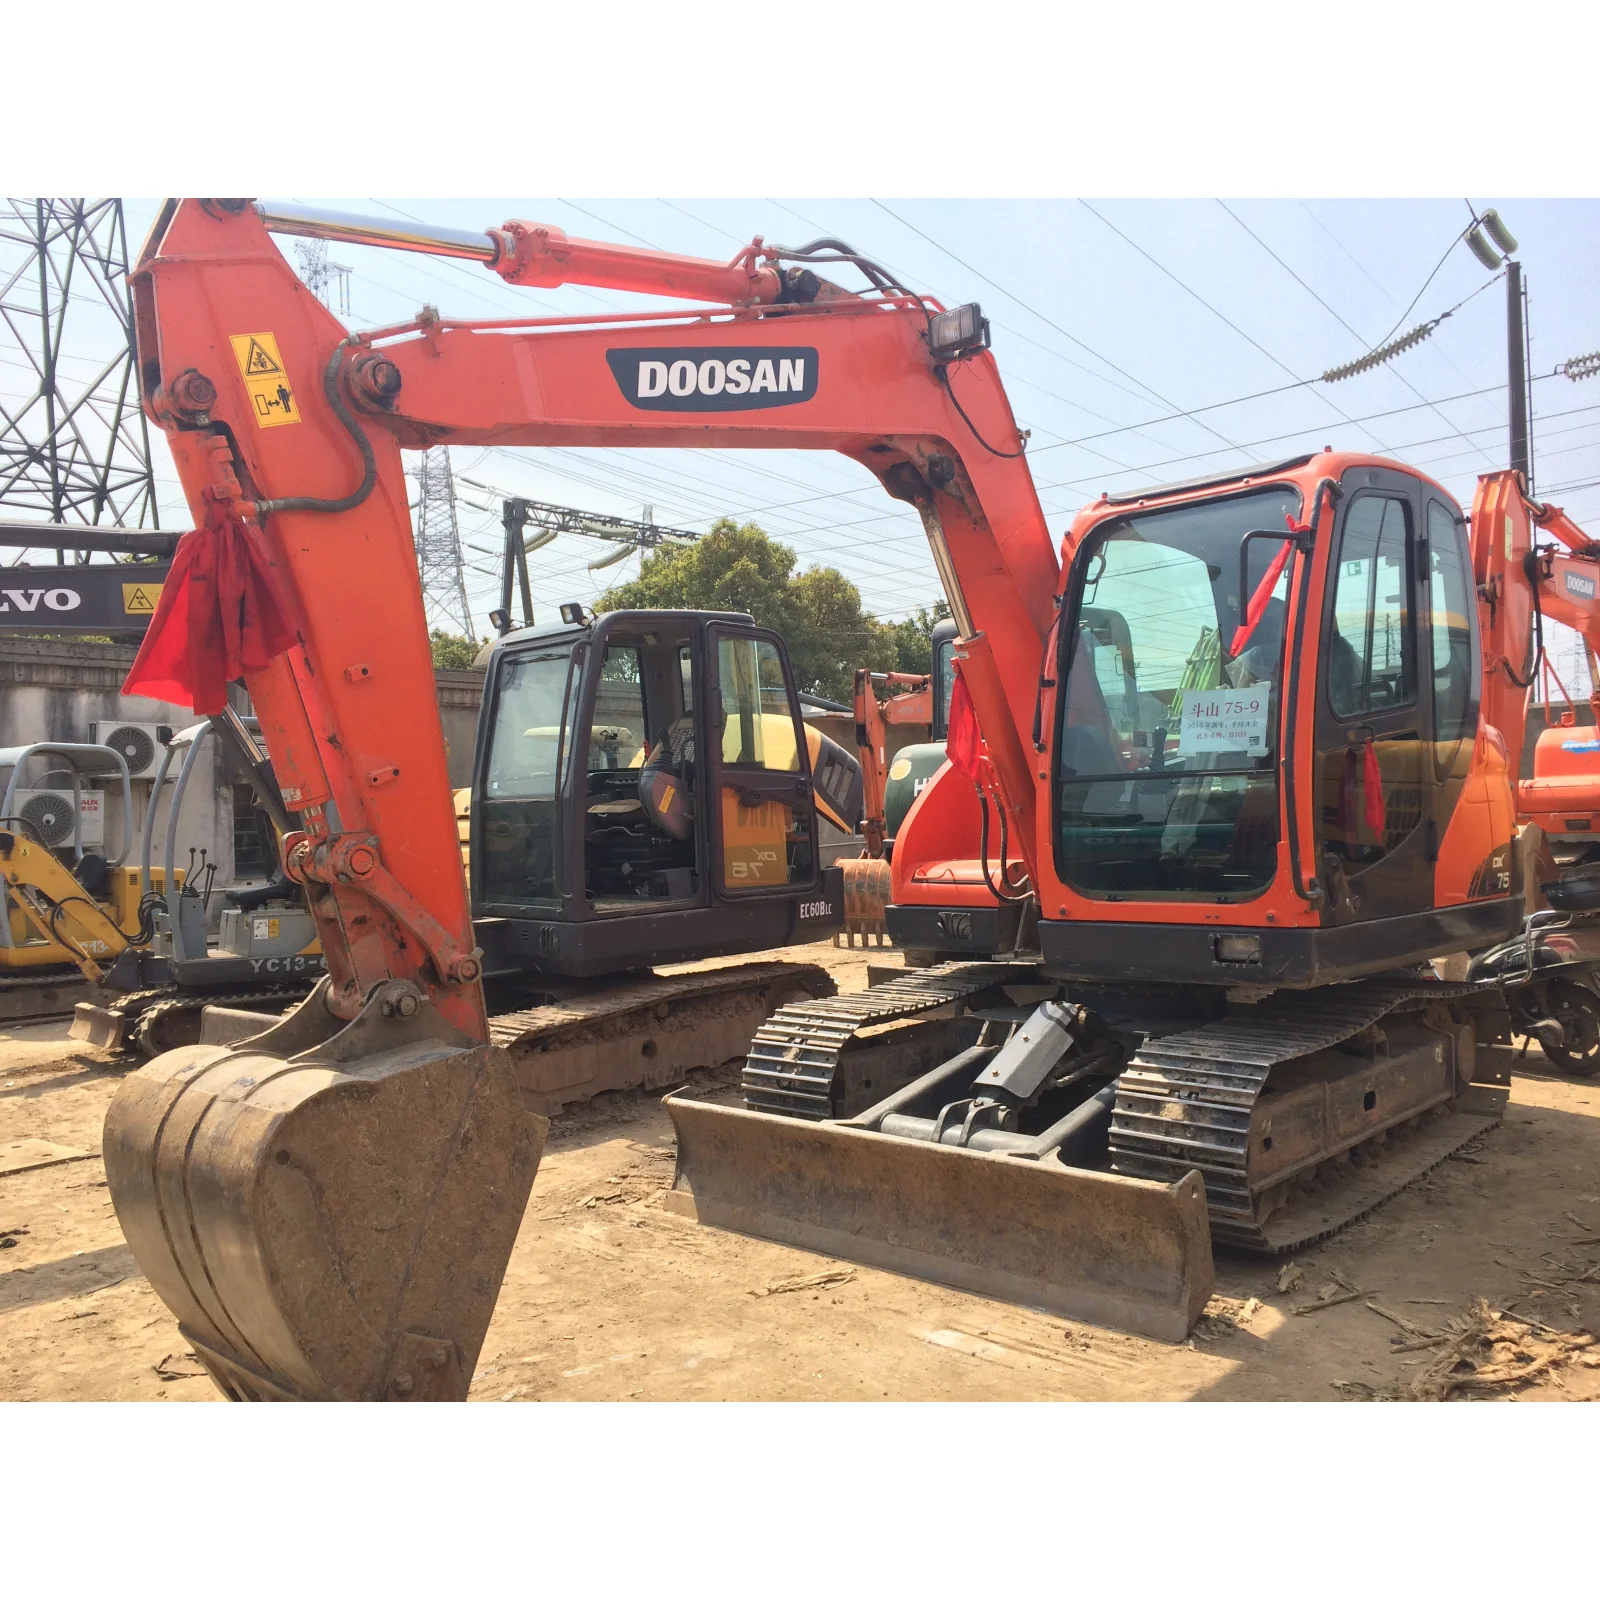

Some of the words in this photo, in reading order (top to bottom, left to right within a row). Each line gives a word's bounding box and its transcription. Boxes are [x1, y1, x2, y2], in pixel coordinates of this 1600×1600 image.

[637, 359, 805, 398] DOOSAN
[1567, 575, 1594, 596] DOOSAN
[0, 588, 81, 612] VO
[1189, 702, 1219, 718] 斗山
[1224, 700, 1260, 715] 75-9
[1497, 871, 1510, 889] 75
